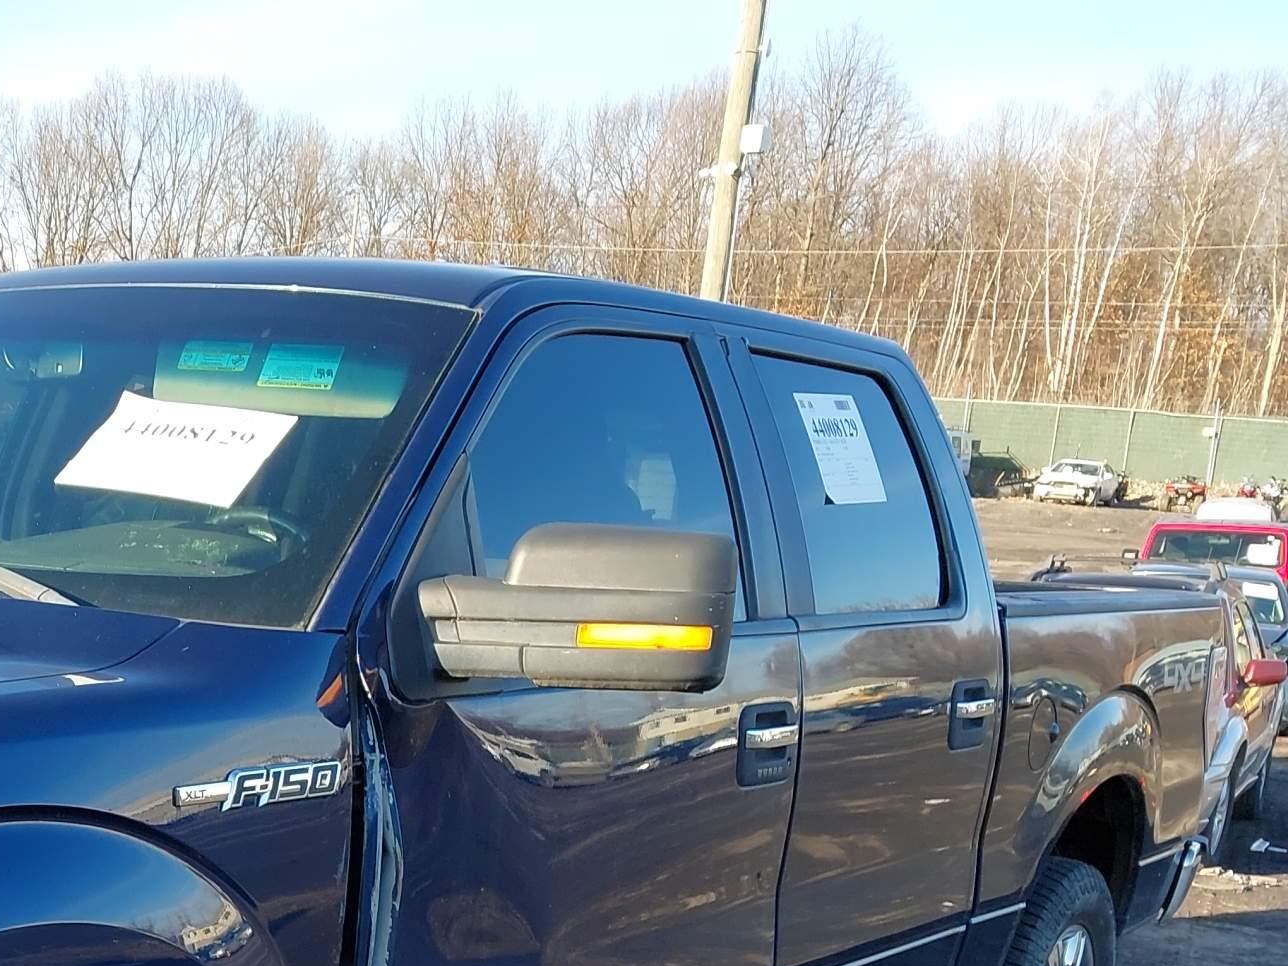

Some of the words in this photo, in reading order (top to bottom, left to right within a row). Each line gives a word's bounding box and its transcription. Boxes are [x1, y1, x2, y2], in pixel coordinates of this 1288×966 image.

[811, 416, 859, 438] 44008129
[184, 789, 208, 802] XLT
[221, 761, 342, 812] F-150
